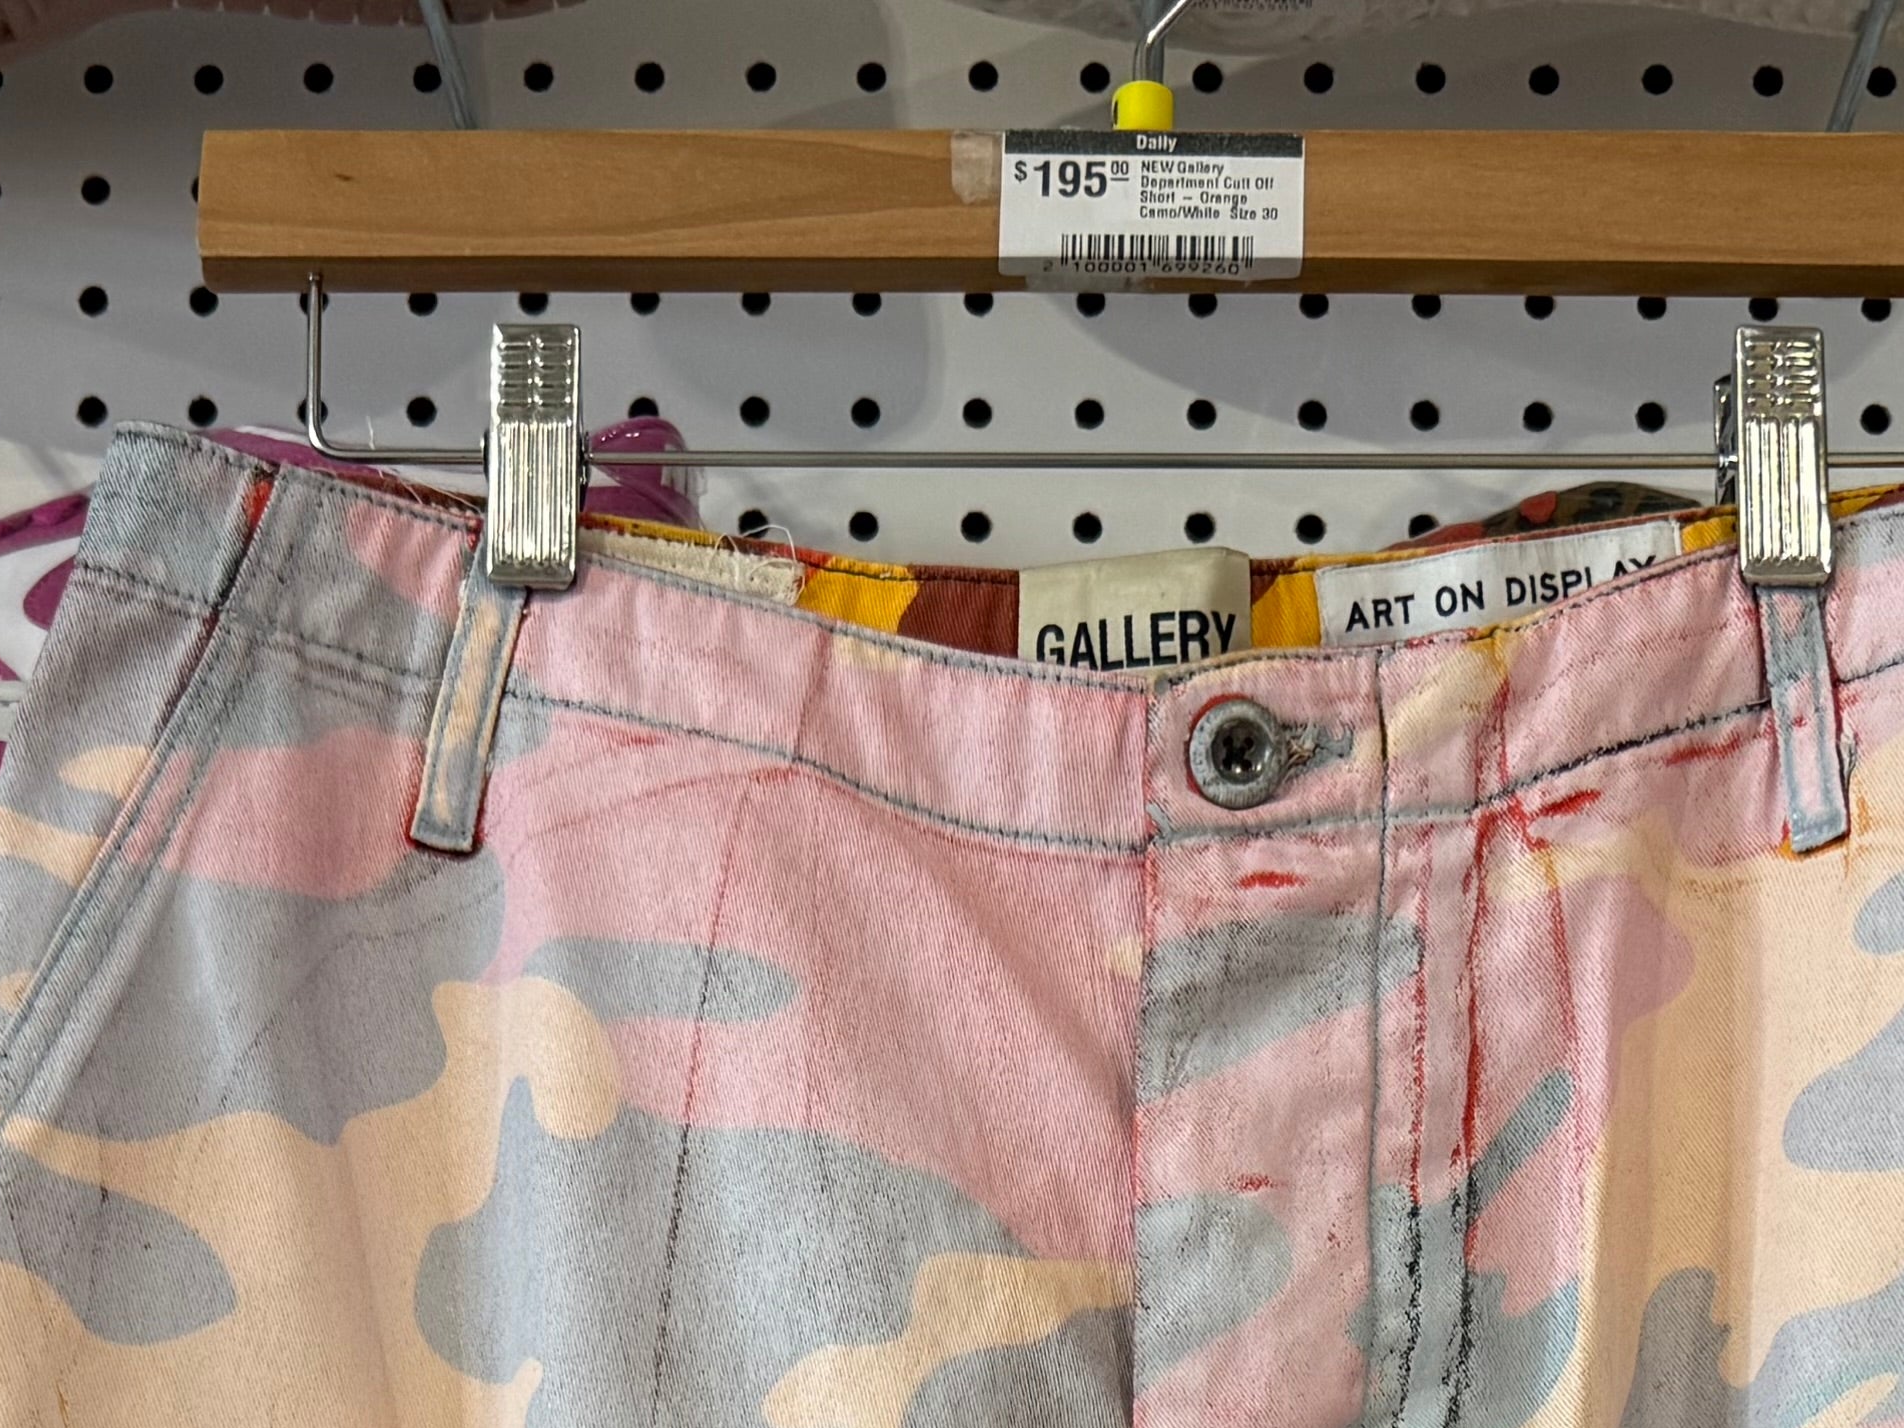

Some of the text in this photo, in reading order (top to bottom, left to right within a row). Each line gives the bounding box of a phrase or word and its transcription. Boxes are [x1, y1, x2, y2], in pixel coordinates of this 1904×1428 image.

[1136, 134, 1177, 152] Daily
[1141, 160, 1225, 177] NEW Gallery
[1140, 175, 1219, 191] Department
[1254, 177, 1275, 190] Off
[1140, 190, 1176, 204] Short
[1199, 191, 1248, 207] Orange
[1139, 206, 1279, 220] Camo/White Size 30
[1345, 592, 1415, 633] ART
[1435, 580, 1485, 618] ON
[1036, 610, 1237, 672] GALLERY
